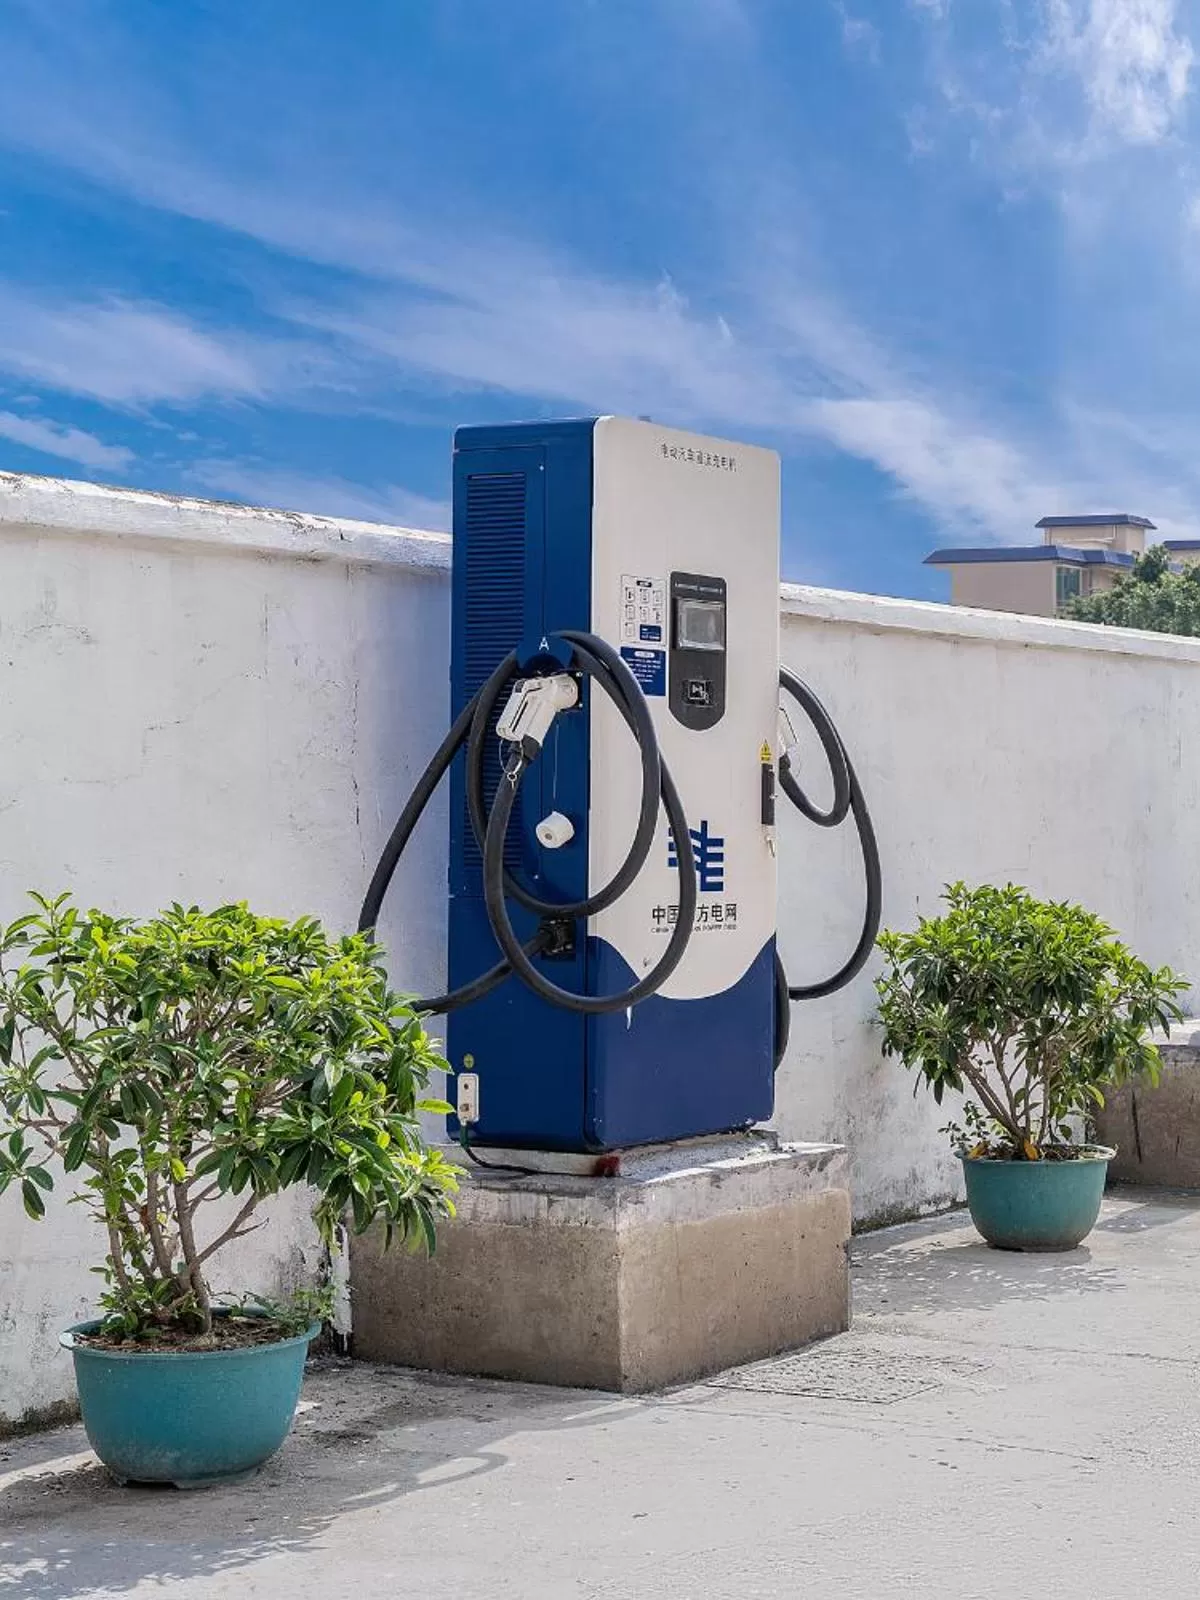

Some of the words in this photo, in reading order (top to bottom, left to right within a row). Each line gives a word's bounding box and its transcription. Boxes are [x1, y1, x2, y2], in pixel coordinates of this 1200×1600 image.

[538, 637, 550, 651] A
[652, 904, 737, 925] 中国方电网
